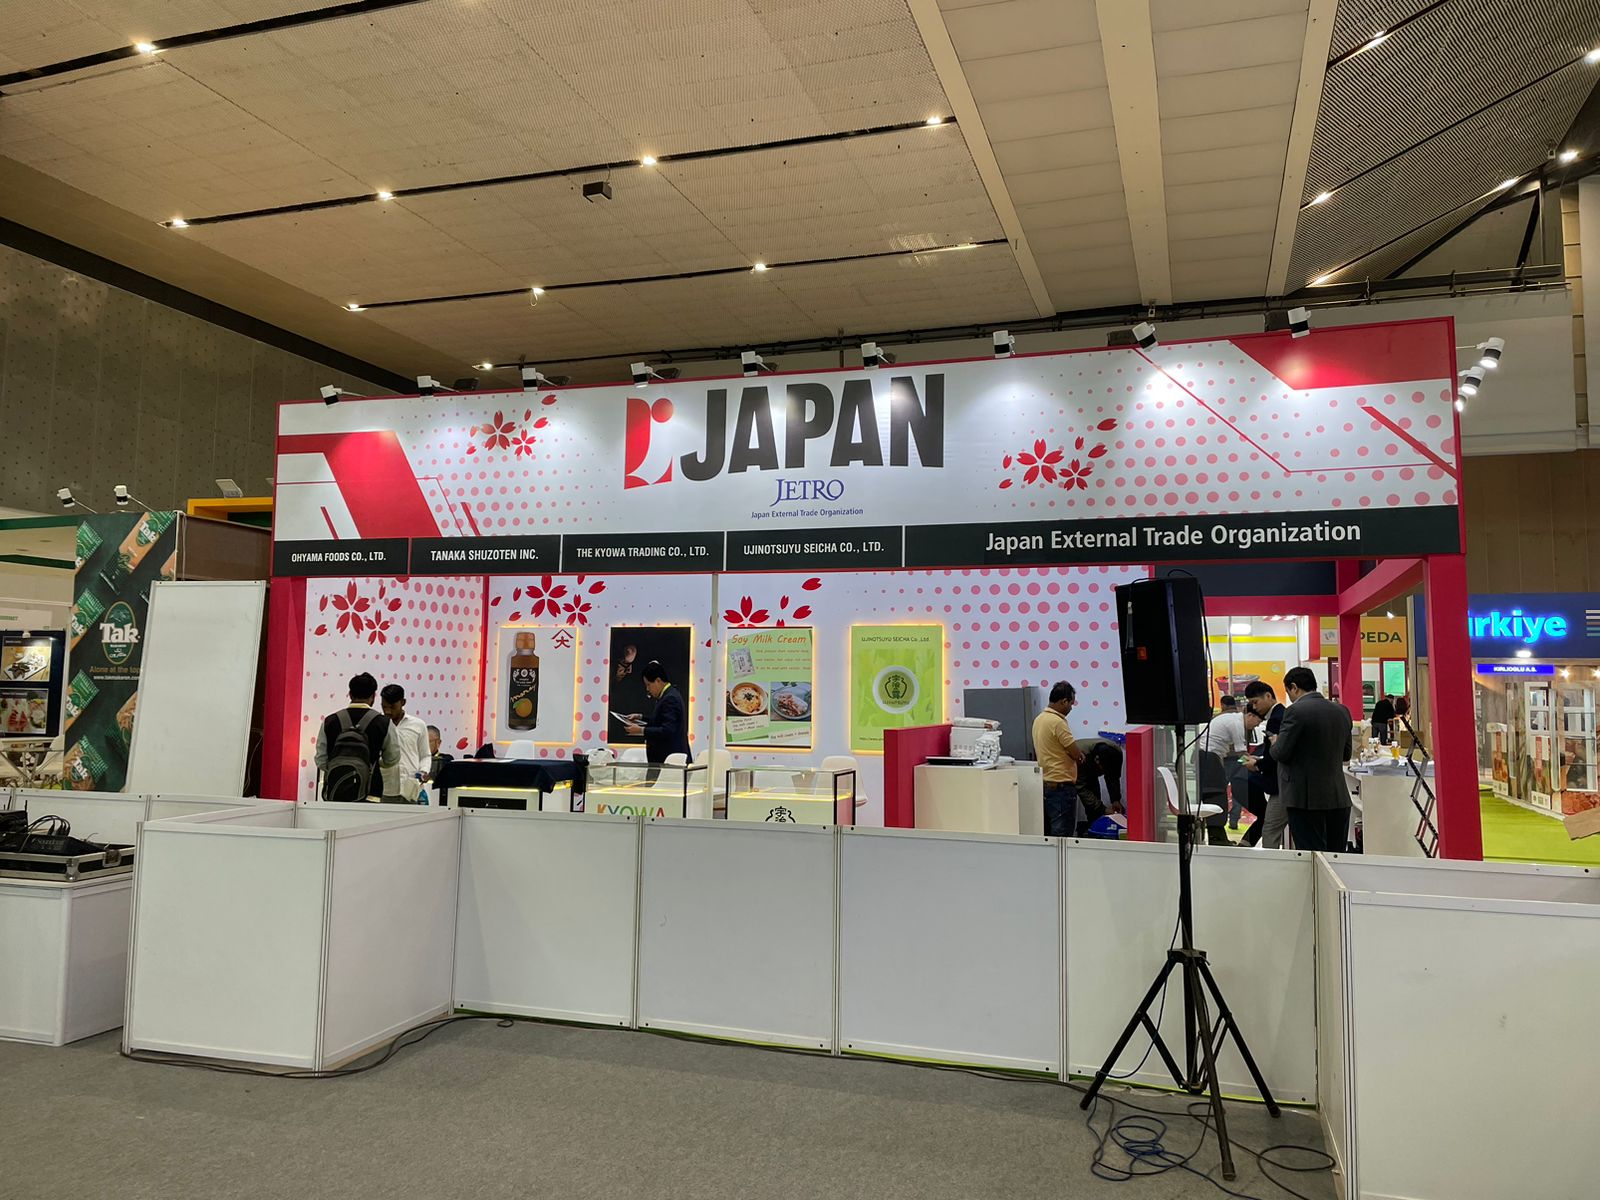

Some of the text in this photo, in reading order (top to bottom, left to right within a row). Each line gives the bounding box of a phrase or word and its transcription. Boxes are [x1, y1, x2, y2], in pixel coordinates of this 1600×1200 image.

[680, 374, 945, 481] JAPAN
[769, 479, 845, 507] JETRO
[751, 507, 864, 520] Japan External Trade Organization
[985, 520, 1362, 555] Japan External Trade Organization
[430, 548, 539, 561] TANAKA SHUZOTEN INC.
[576, 546, 710, 558] THE KYOWA TRADING CO., LTD.
[743, 541, 885, 556] UJINOTSUYU SEICHA CO., LTD.
[291, 551, 387, 563] OHYAMA FOODS CO., LTD.
[99, 622, 140, 643] Tak
[731, 633, 807, 646] Soy Milk Cream
